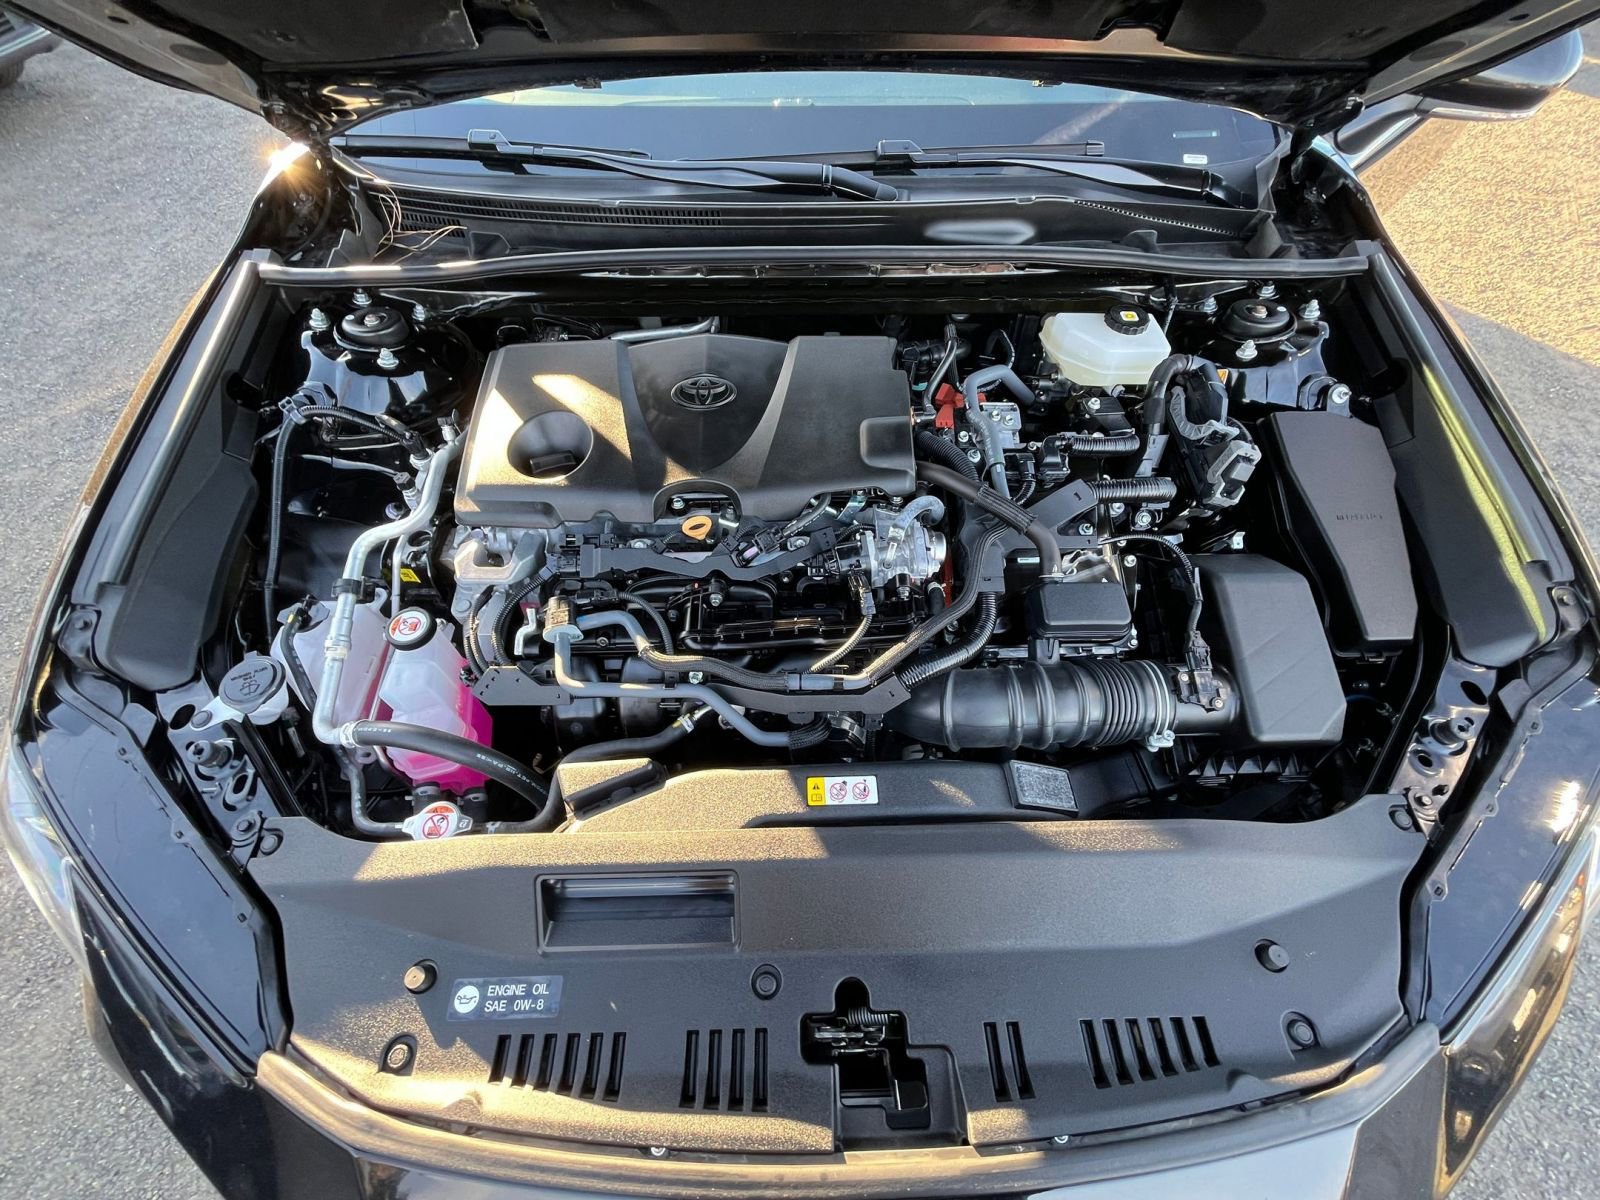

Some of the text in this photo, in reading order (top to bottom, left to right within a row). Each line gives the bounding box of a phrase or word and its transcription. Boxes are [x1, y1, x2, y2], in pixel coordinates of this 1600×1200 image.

[487, 983, 550, 996] ENGINE OIL
[484, 999, 544, 1012] SAE 0W-8
